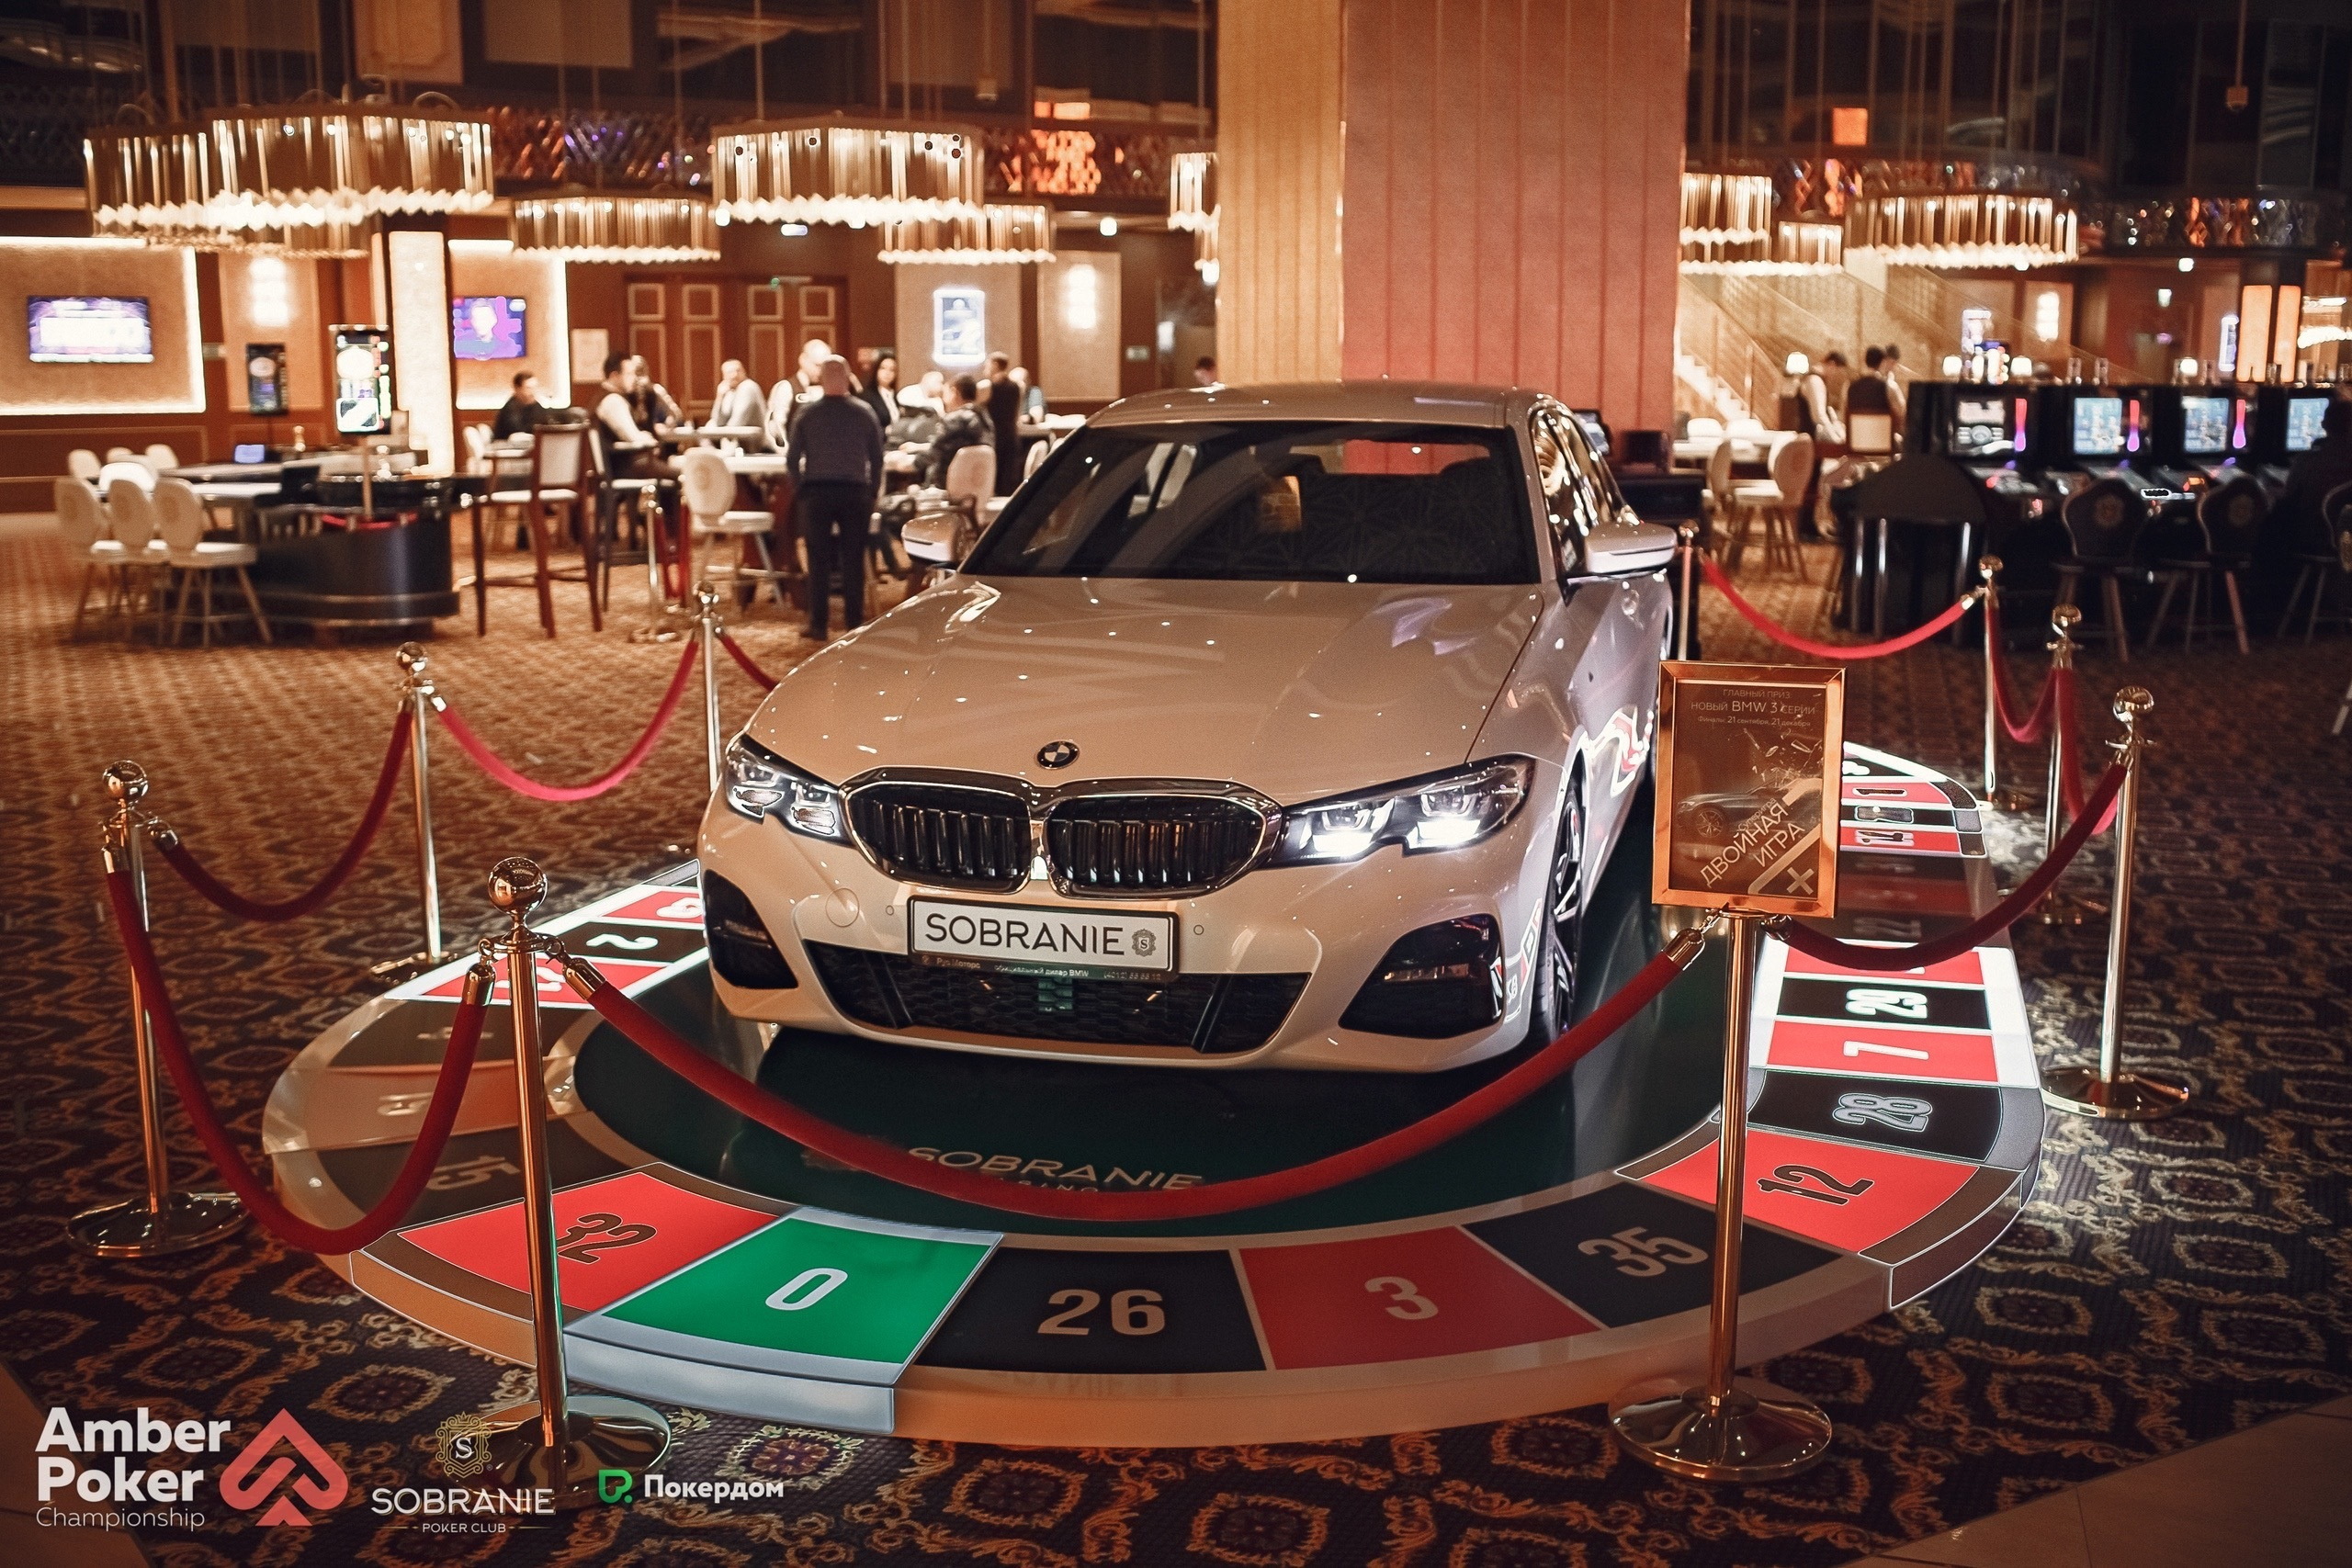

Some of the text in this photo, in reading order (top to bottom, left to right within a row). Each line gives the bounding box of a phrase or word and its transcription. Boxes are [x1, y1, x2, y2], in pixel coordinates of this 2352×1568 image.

[1690, 701, 1728, 711] НОВЫЙ
[1732, 701, 1767, 713] BMW
[1770, 702, 1778, 713] 3
[1723, 688, 1765, 698] ГЛАВНЫЙ
[1700, 803, 1789, 888] ДВОЙНАЯ
[1753, 822, 1805, 868] ИГРА
[925, 912, 1125, 956] SOBRANIE
[1069, 969, 1090, 977] BMW
[1832, 1092, 1933, 1133] 28
[908, 1146, 1203, 1191] SOBRANIE
[1757, 1164, 1875, 1206] 12
[556, 1212, 658, 1265] 32
[1577, 1225, 1709, 1278] 35
[764, 1267, 849, 1312] 0
[1363, 1275, 1440, 1321] 3
[1037, 1289, 1166, 1337] 26
